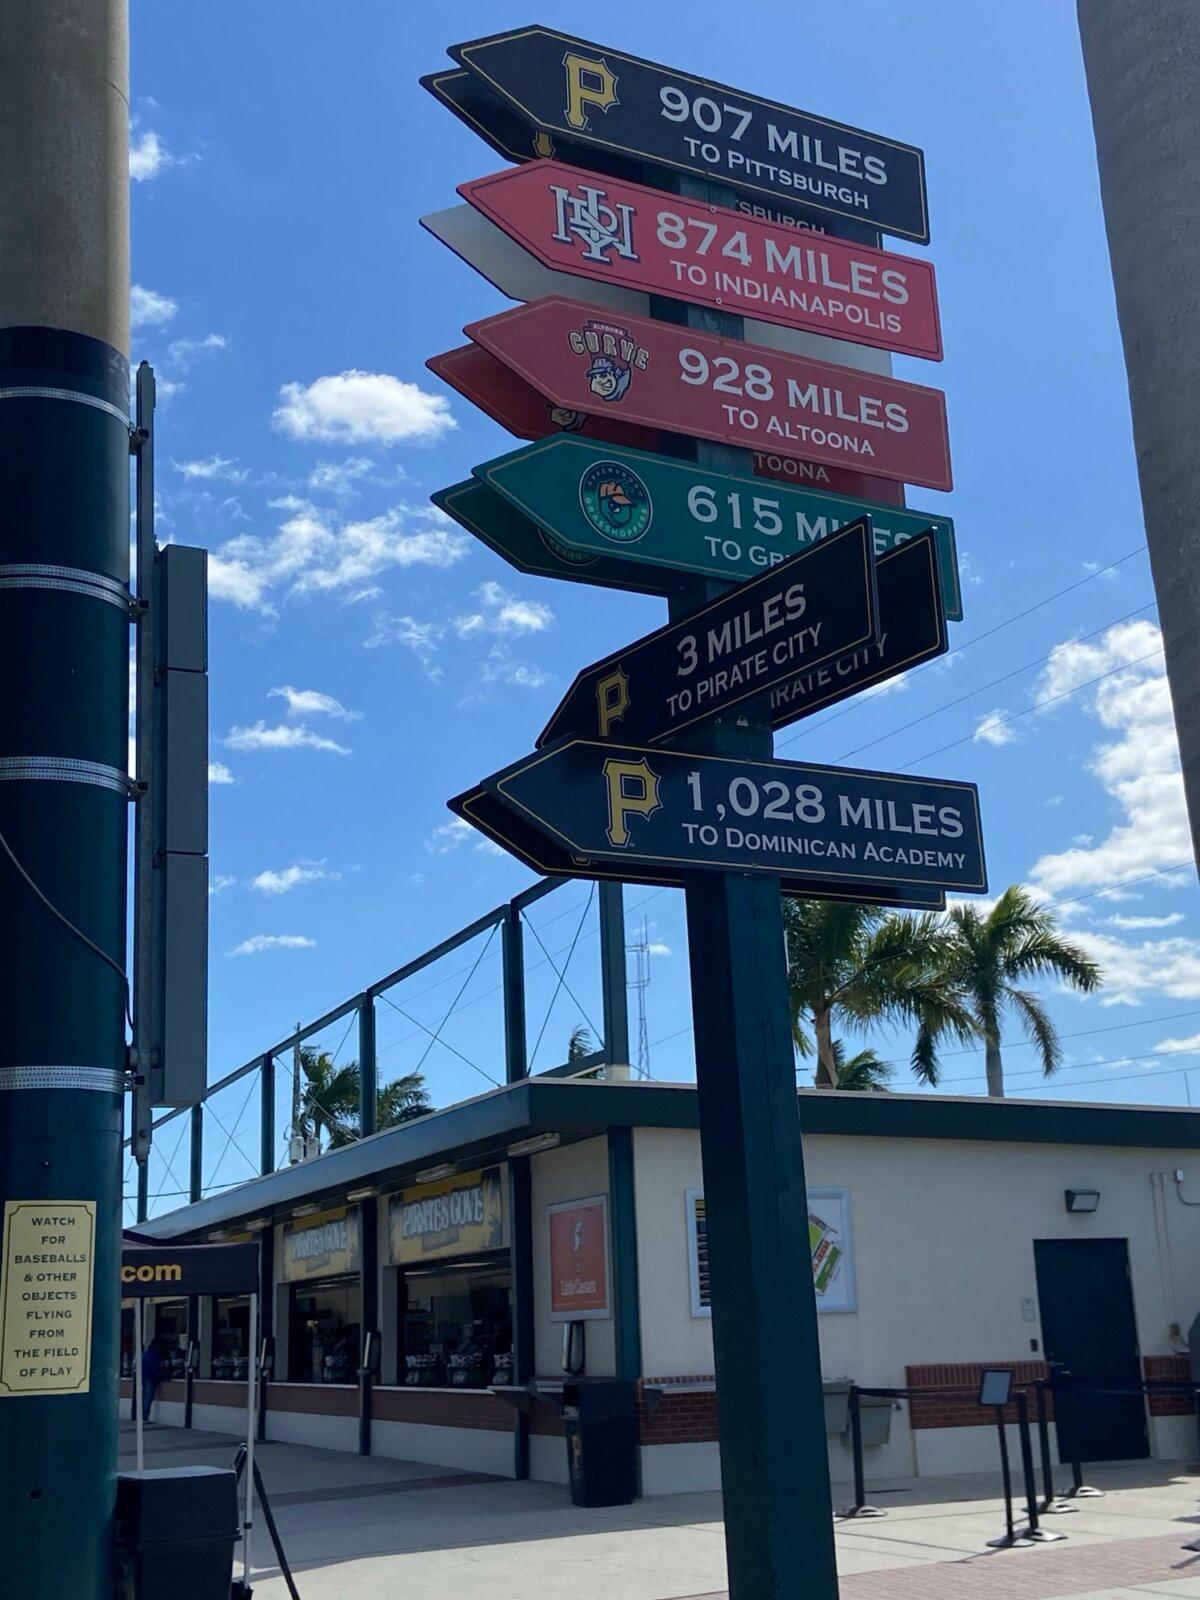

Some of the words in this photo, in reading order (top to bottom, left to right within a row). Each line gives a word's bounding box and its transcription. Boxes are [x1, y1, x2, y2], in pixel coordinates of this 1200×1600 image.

[562, 51, 620, 130] P
[659, 86, 753, 141] 907
[766, 123, 888, 186] MILES
[683, 136, 721, 163] TO
[727, 150, 870, 210] PITTSBURGH
[656, 211, 752, 267] 874
[764, 238, 909, 305] MILES
[670, 259, 707, 286] TO
[714, 271, 902, 333] INDIANAPOLIS
[568, 331, 650, 371] CURVE
[678, 348, 774, 401] 928
[786, 378, 910, 433] MILES
[721, 404, 759, 430] TO
[765, 415, 875, 457] ALTOONA
[753, 452, 831, 483] TOONA
[687, 485, 783, 536] 615
[704, 535, 742, 561] TO
[676, 635, 699, 677] 3
[707, 583, 807, 663] MILES
[666, 689, 692, 717] TO
[696, 649, 769, 704] PIRATE
[772, 622, 823, 665] CITY
[769, 667, 832, 709] IRATE
[836, 633, 888, 677] CITY
[602, 757, 663, 848] P
[687, 771, 826, 824] 1,028
[838, 795, 964, 839] MILES
[682, 822, 719, 846] TO
[725, 827, 856, 860] DOMINICAN
[862, 842, 966, 870] ACADEMY
[31, 1217, 75, 1226] WATCH
[41, 1236, 66, 1245] FOR
[14, 1254, 87, 1264] BASEBALLS
[24, 1273, 33, 1282] &
[36, 1272, 77, 1282] OTHER
[22, 1291, 77, 1301] OBJECTS
[26, 1310, 72, 1320] FLYING
[14, 1349, 40, 1358] THE
[44, 1347, 79, 1357] FIELD
[29, 1329, 65, 1339] FROM
[19, 1368, 37, 1378] OF
[41, 1366, 72, 1377] PLAY
